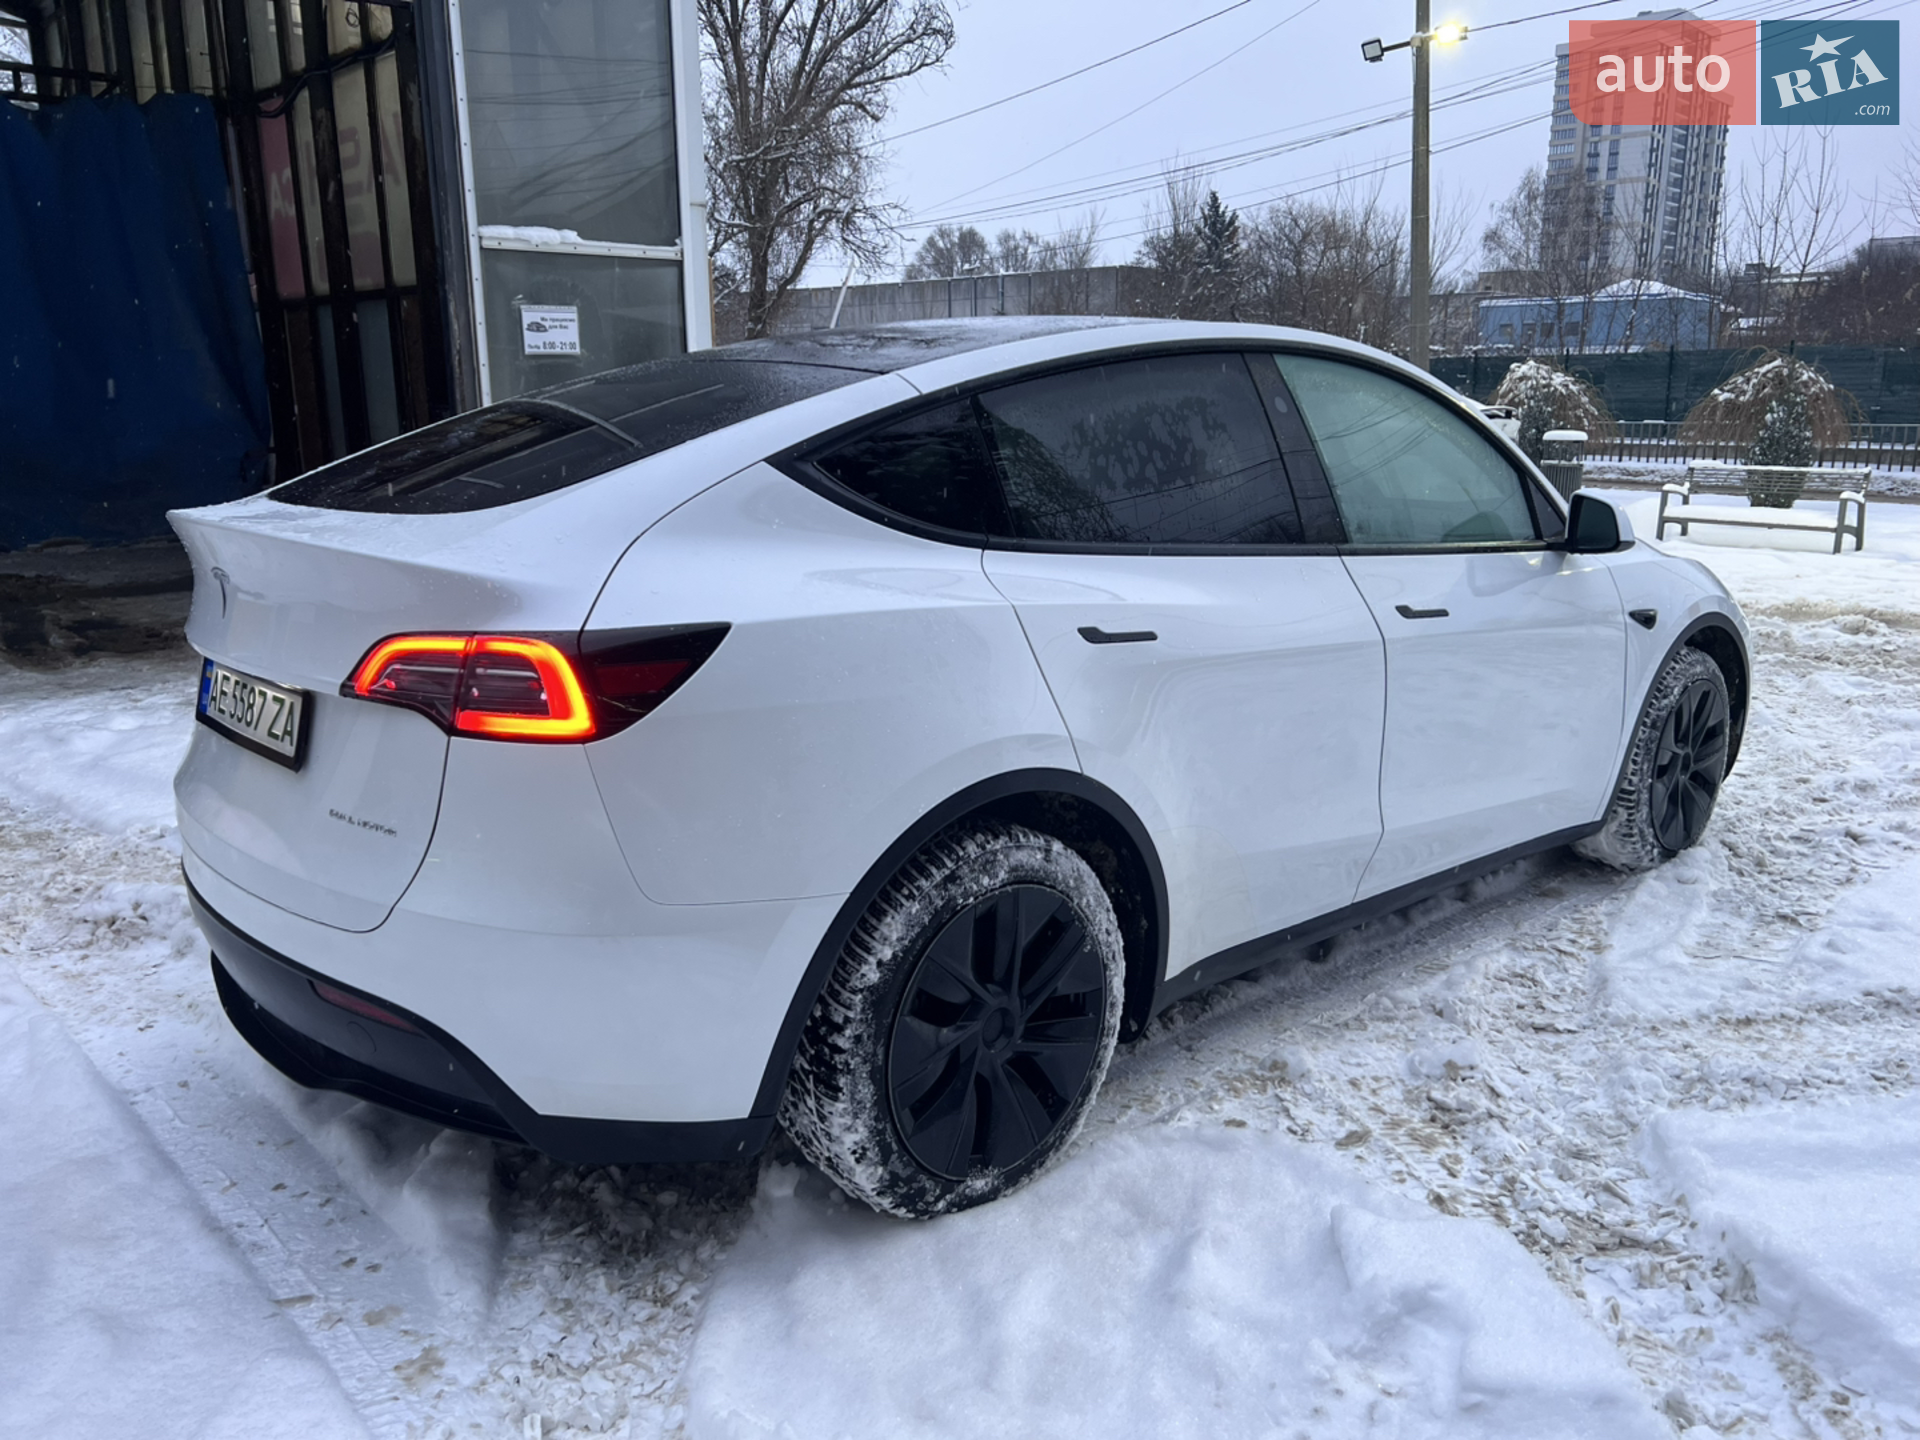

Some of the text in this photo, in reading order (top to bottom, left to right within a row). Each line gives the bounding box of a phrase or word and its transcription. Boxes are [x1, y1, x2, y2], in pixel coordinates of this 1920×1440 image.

[209, 670, 294, 747] AE 5587 ZA
